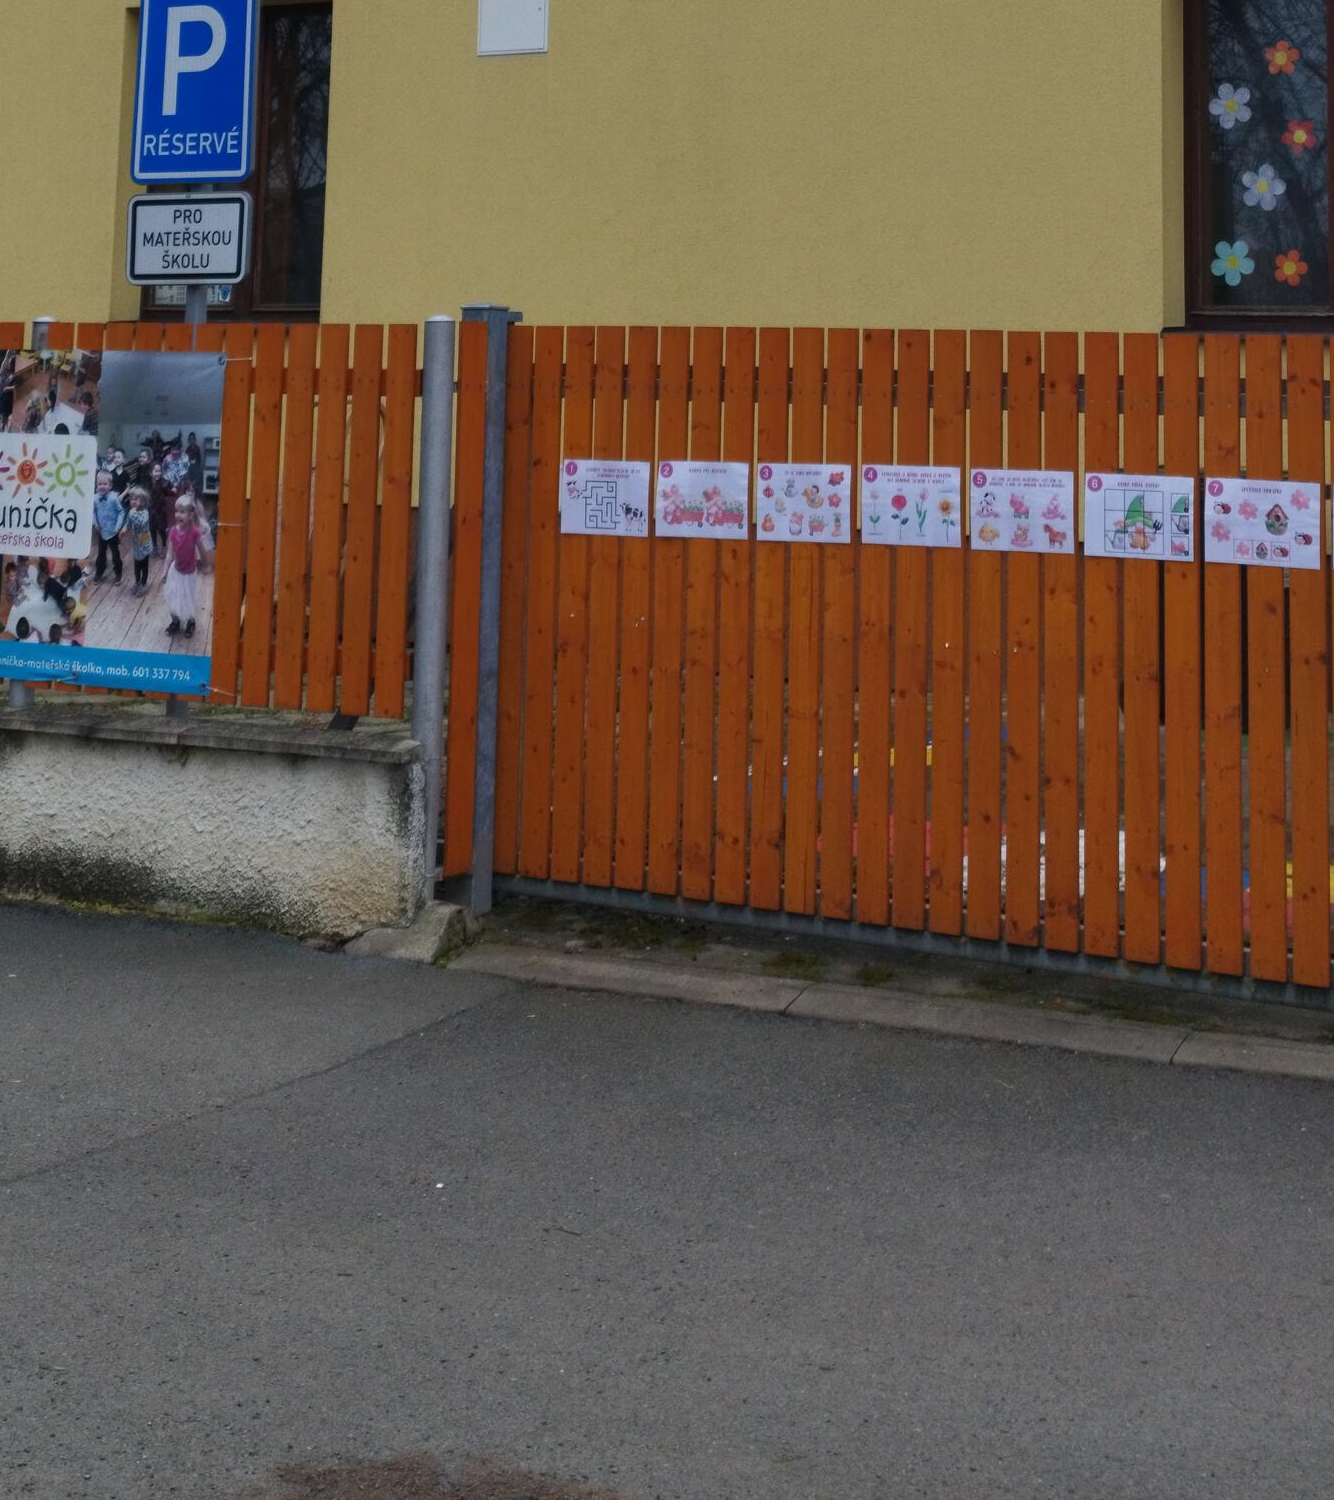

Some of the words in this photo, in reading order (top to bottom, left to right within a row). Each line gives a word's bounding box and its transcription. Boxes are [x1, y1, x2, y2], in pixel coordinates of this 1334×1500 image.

[162, 4, 227, 116] P
[143, 126, 239, 156] RÉSERVÉ
[173, 209, 203, 225] PRO
[142, 227, 232, 247] MATEŘSKOU
[161, 248, 210, 269] ŠKOLU
[1091, 479, 1098, 488] 6
[34, 533, 65, 549] škola
[106, 664, 131, 677] mob.
[132, 666, 149, 677] 601
[152, 668, 170, 680] 337
[172, 669, 191, 681] 794
